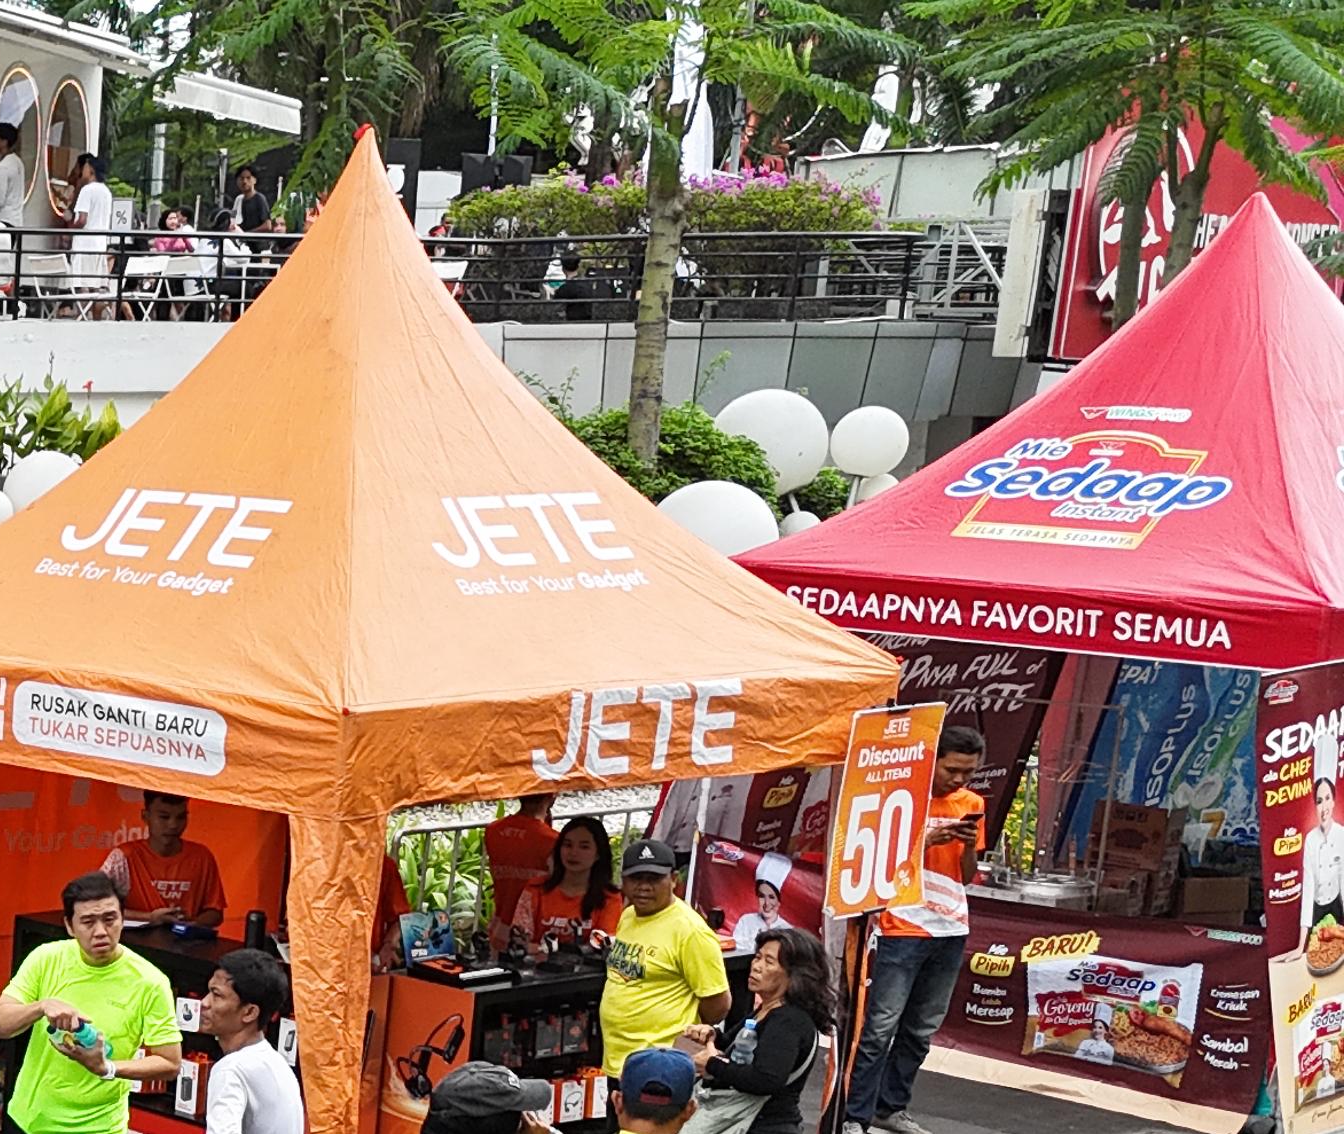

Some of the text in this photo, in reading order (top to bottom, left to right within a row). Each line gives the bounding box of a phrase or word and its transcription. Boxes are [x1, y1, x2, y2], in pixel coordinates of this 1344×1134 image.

[1008, 438, 1069, 460] Mie
[947, 458, 1231, 514] Sedaap
[1053, 503, 1146, 522] Instant
[61, 487, 293, 568] JETE
[432, 491, 635, 568] JETE
[967, 525, 1135, 546] JELAS TERASA SEDAPNYA
[34, 557, 234, 597] Best for Your Gadget
[455, 569, 649, 597] Best for Your Gadget
[786, 585, 1232, 649] SEDAAPNYA FAVORIT SEMUA
[964, 651, 1049, 685] FULL of
[946, 681, 1035, 716] TASTE
[30, 693, 208, 738] RUSAK GANTI BARU
[532, 677, 742, 781] JETE
[884, 717, 911, 735] JETE
[29, 716, 207, 762] TUKAR SEPUASNYA
[1145, 684, 1197, 807] ISOPLUS
[1262, 705, 1344, 764] SEDAA
[858, 741, 926, 768] Discount
[1279, 756, 1312, 781] CHEF
[866, 767, 912, 782] ALL ITEMS
[1265, 778, 1313, 808] DEVINA
[4, 828, 64, 855] Your
[840, 789, 913, 906] 50
[987, 943, 1009, 956] Mie
[1026, 931, 1094, 959] BARU!
[975, 955, 1011, 974] Pipih
[1066, 967, 1157, 994] Sedaap
[965, 1002, 1014, 1021] Meresap
[1043, 999, 1095, 1017] Goreng
[1199, 1034, 1250, 1053] Sambal
[1204, 1052, 1239, 1070] Merah
